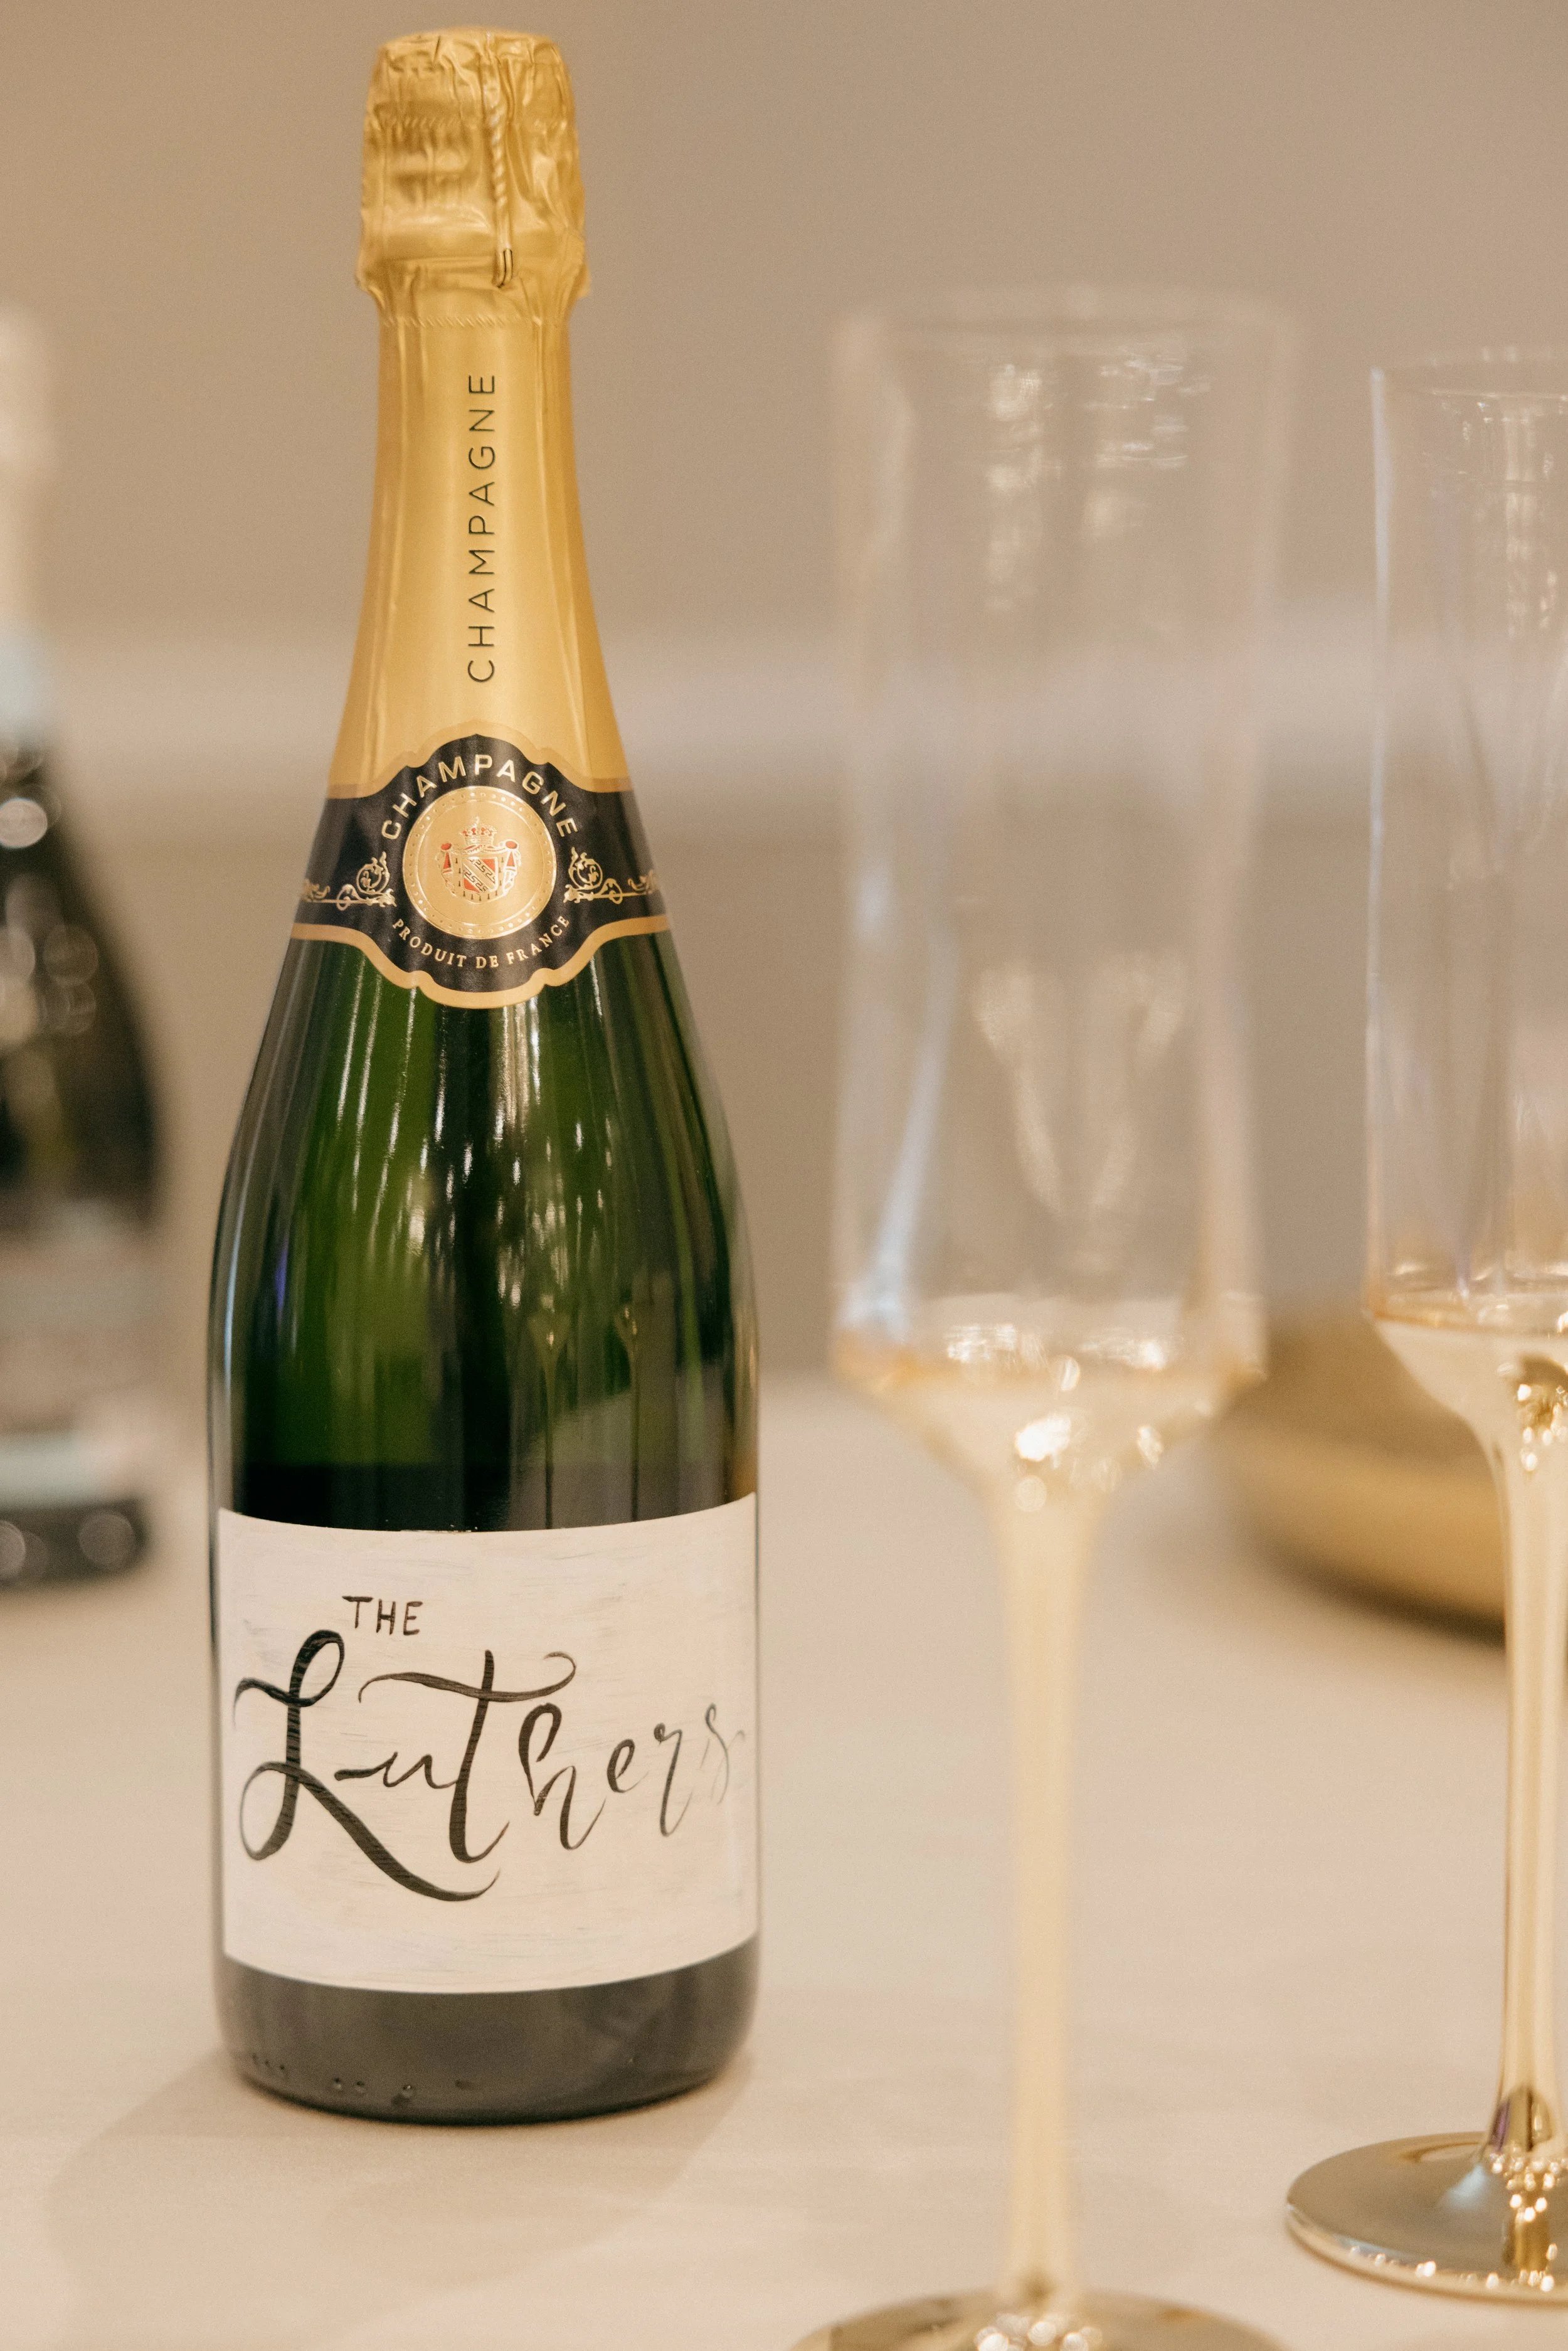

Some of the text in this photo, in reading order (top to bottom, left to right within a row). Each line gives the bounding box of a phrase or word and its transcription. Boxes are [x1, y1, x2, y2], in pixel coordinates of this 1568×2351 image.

[467, 374, 495, 683] CHAMPAGNE
[381, 753, 578, 841] CHAMPAGNE
[392, 915, 570, 969] PRODUIT DE FRANCE
[341, 1595, 423, 1637] THE
